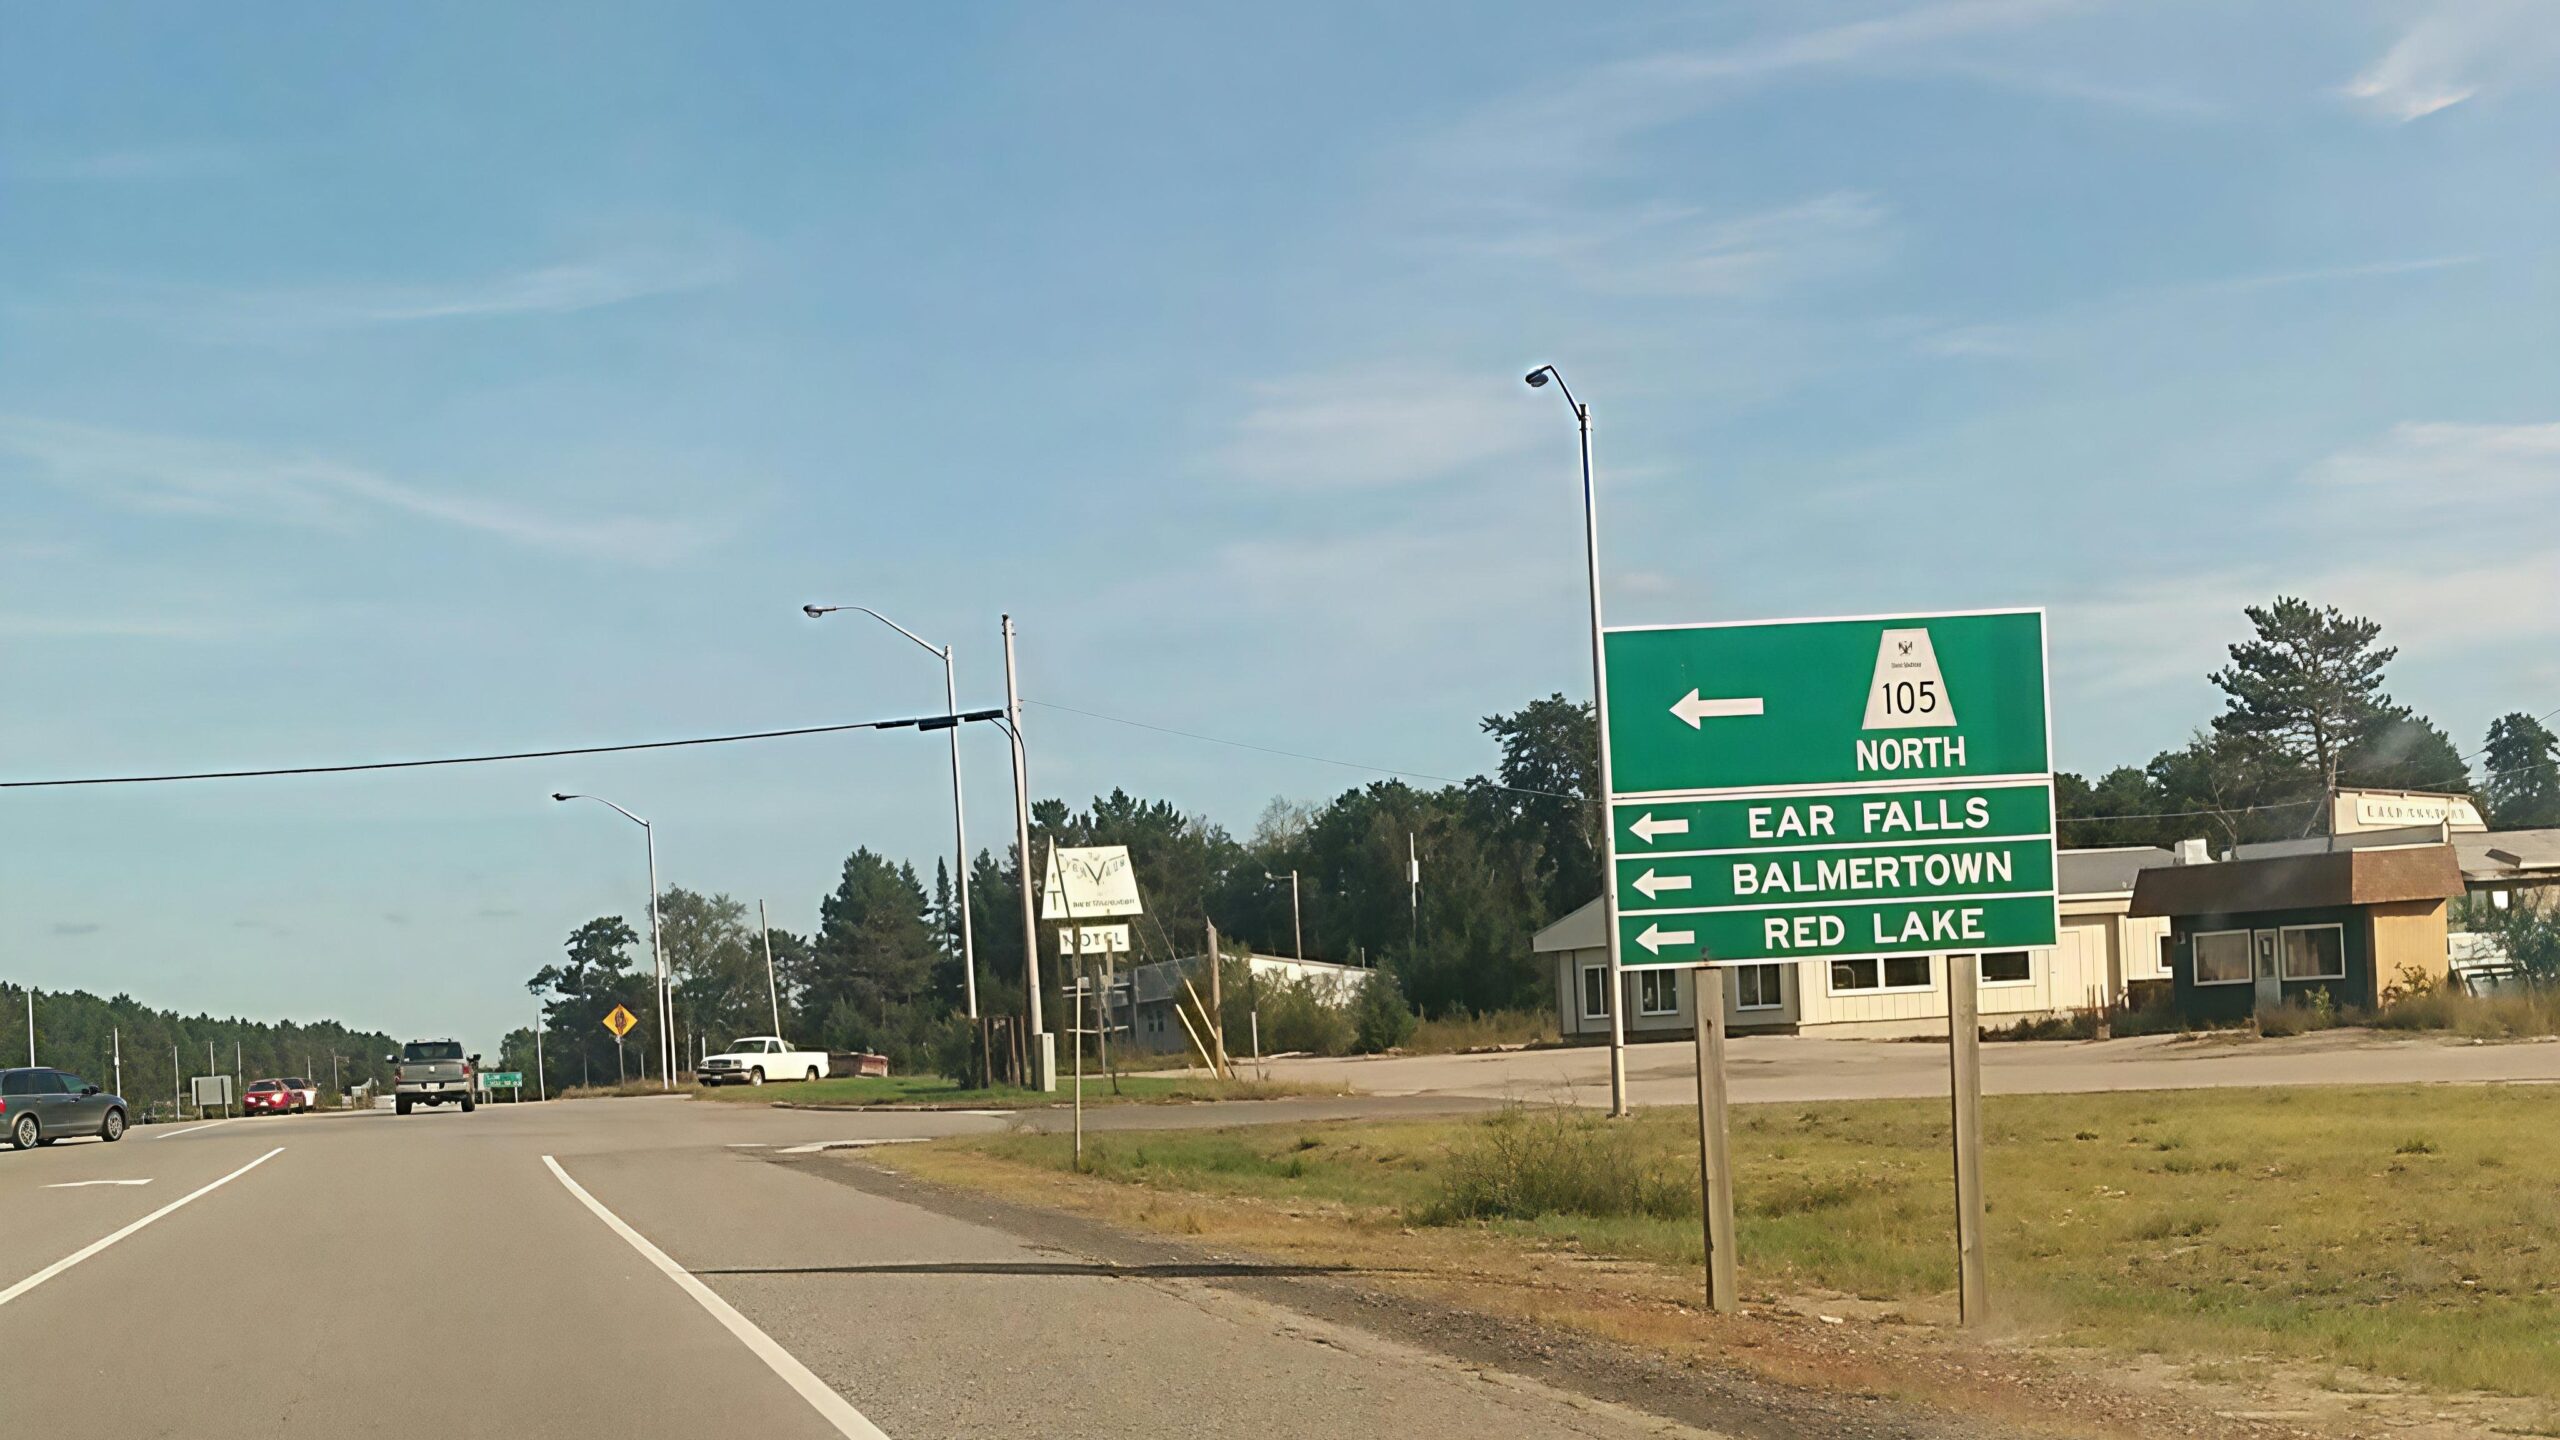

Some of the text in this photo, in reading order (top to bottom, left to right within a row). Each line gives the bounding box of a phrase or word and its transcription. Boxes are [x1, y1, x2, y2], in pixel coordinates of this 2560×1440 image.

[1882, 681, 1936, 715] 105
[1856, 736, 1966, 771] NORTH
[1748, 796, 1990, 839] EAR FALLS
[1732, 851, 2012, 895] BALMERTOWN
[1764, 908, 1986, 950] RED LAKE
